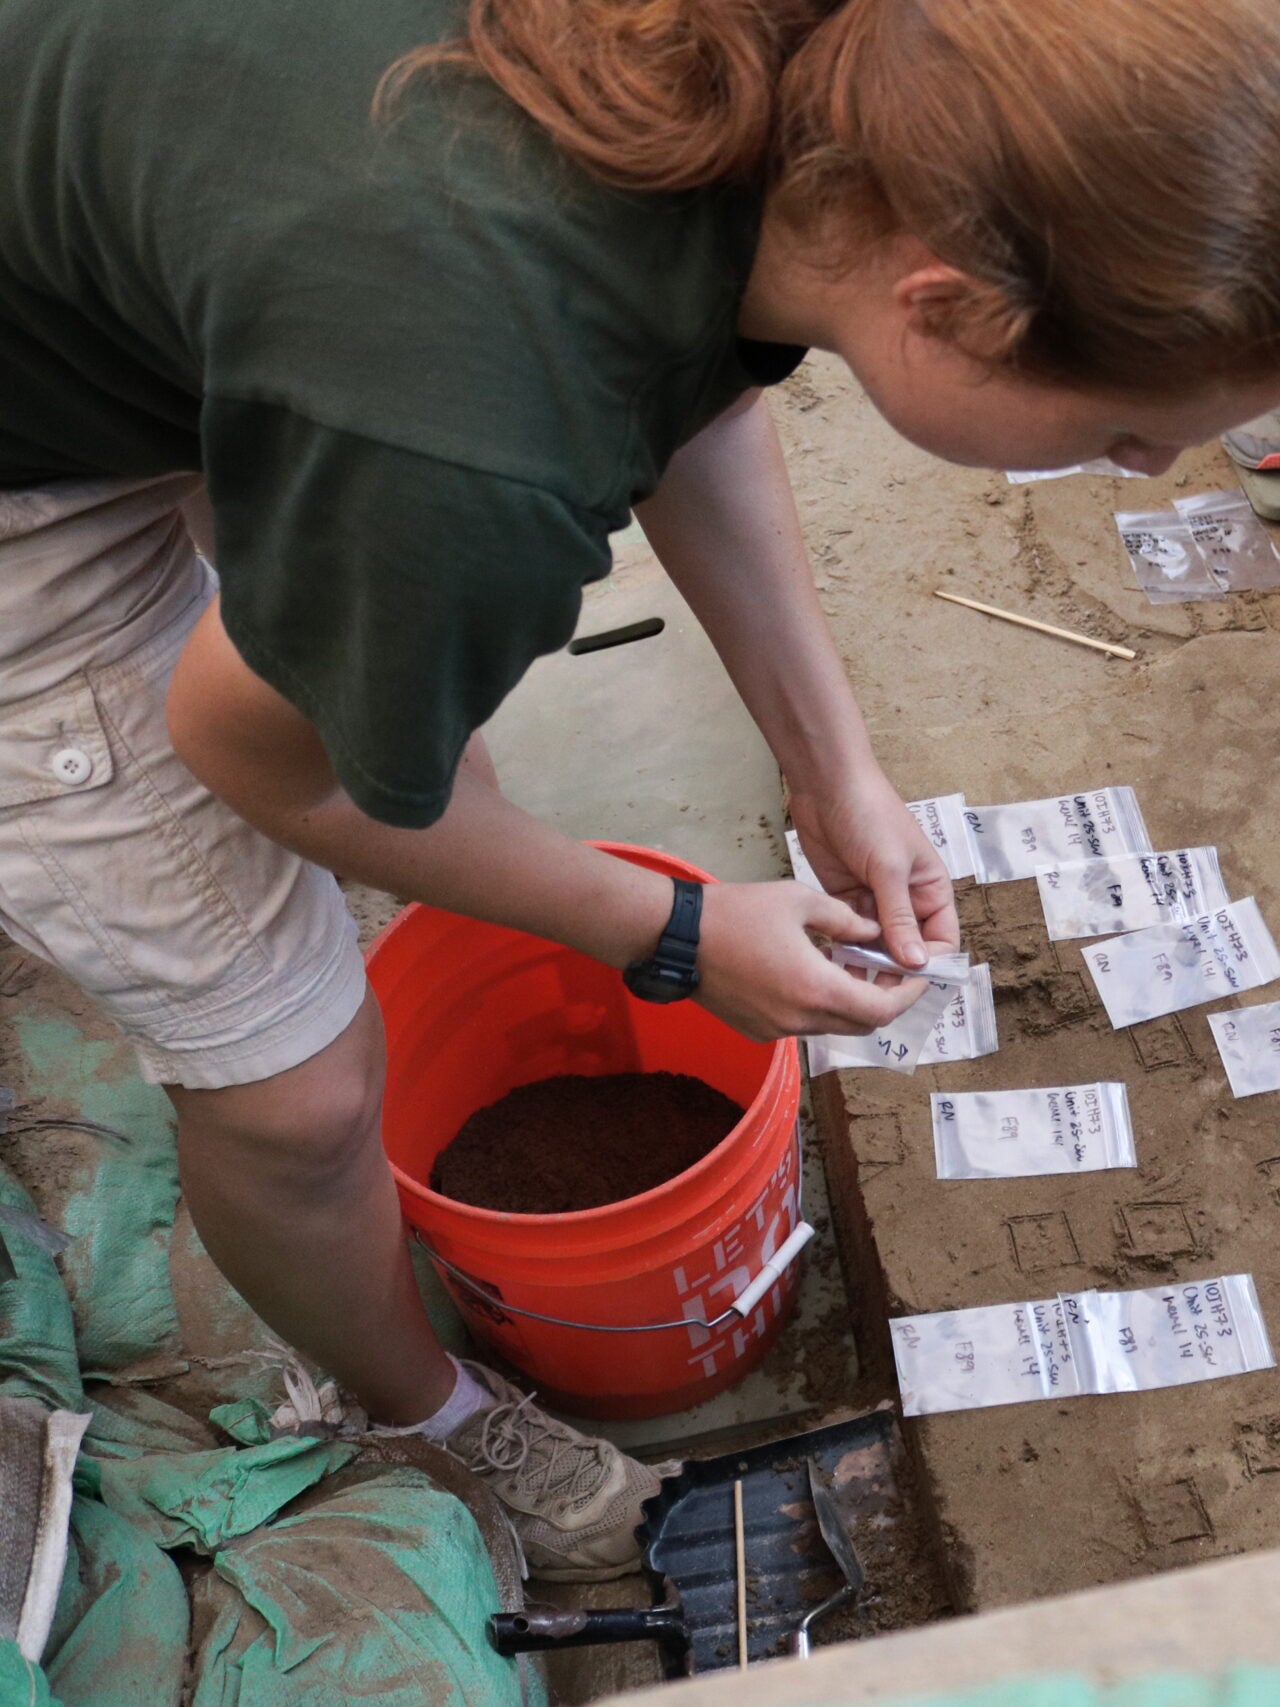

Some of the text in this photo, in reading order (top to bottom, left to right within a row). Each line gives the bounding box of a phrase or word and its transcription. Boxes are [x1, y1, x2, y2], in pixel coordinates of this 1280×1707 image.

[1067, 833, 1082, 845] 14
[1197, 916, 1216, 940] Unit
[1200, 961, 1216, 978] 14
[938, 1101, 955, 1121] RN
[1065, 1092, 1076, 1117] Unit
[1033, 1306, 1049, 1335] Unit
[1180, 1343, 1193, 1358] 14
[1021, 1357, 1040, 1375] 14
